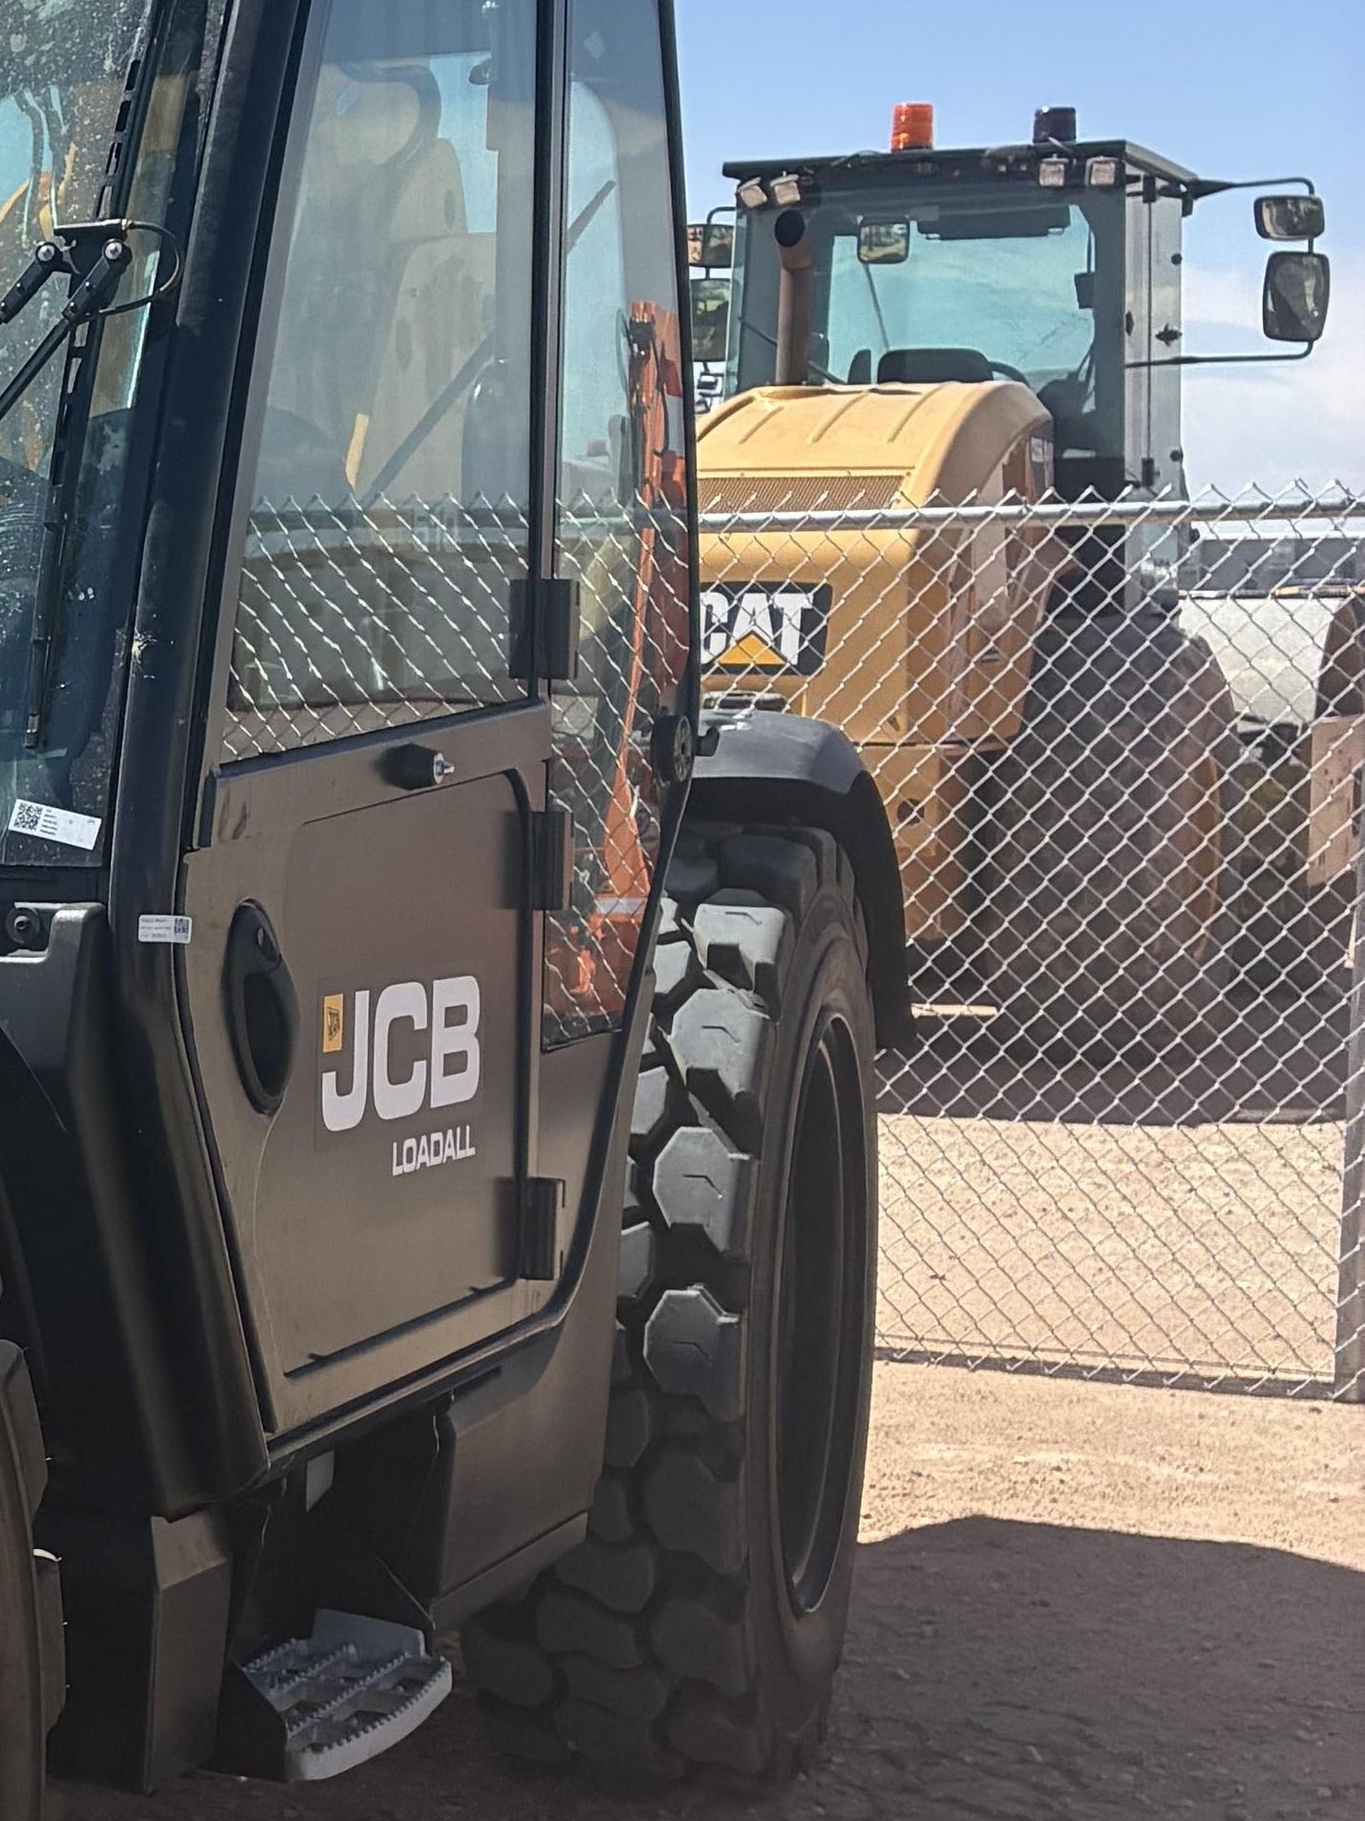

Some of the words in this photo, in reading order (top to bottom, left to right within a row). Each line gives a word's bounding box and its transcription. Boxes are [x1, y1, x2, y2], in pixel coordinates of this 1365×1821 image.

[700, 592, 815, 665] CAT
[322, 975, 481, 1131] JCB
[392, 1125, 476, 1176] LOADALL
